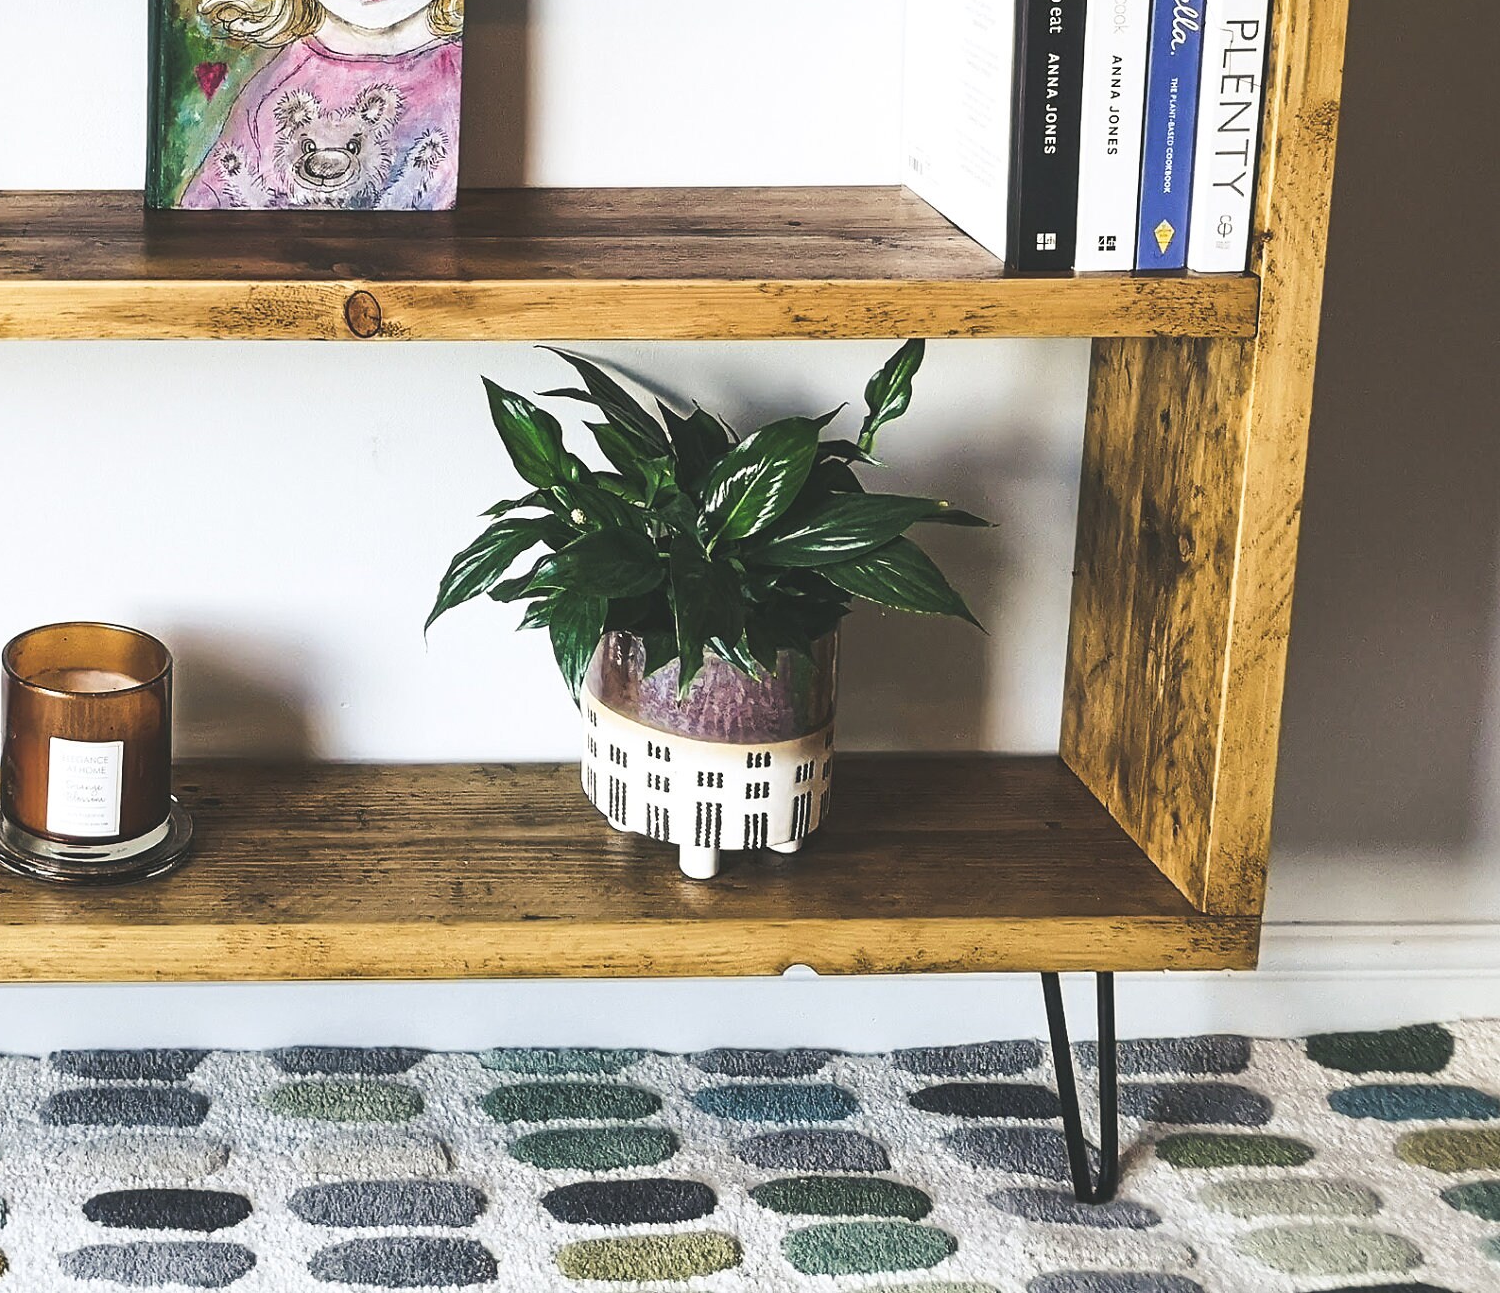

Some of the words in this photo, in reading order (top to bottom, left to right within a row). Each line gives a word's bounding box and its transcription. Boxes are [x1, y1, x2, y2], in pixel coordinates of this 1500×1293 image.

[1049, 6, 1063, 34] eat
[1045, 53, 1060, 99] ANNA
[1109, 55, 1123, 100] ANNA
[1169, 77, 1179, 93] THE
[1043, 104, 1058, 155] JONES
[1106, 105, 1120, 156] JONES
[1166, 94, 1178, 146] PLANT-BASED
[1212, 19, 1260, 198] PLENTY
[1163, 147, 1174, 194] COOKBOOK
[78, 766, 107, 775] HOME
